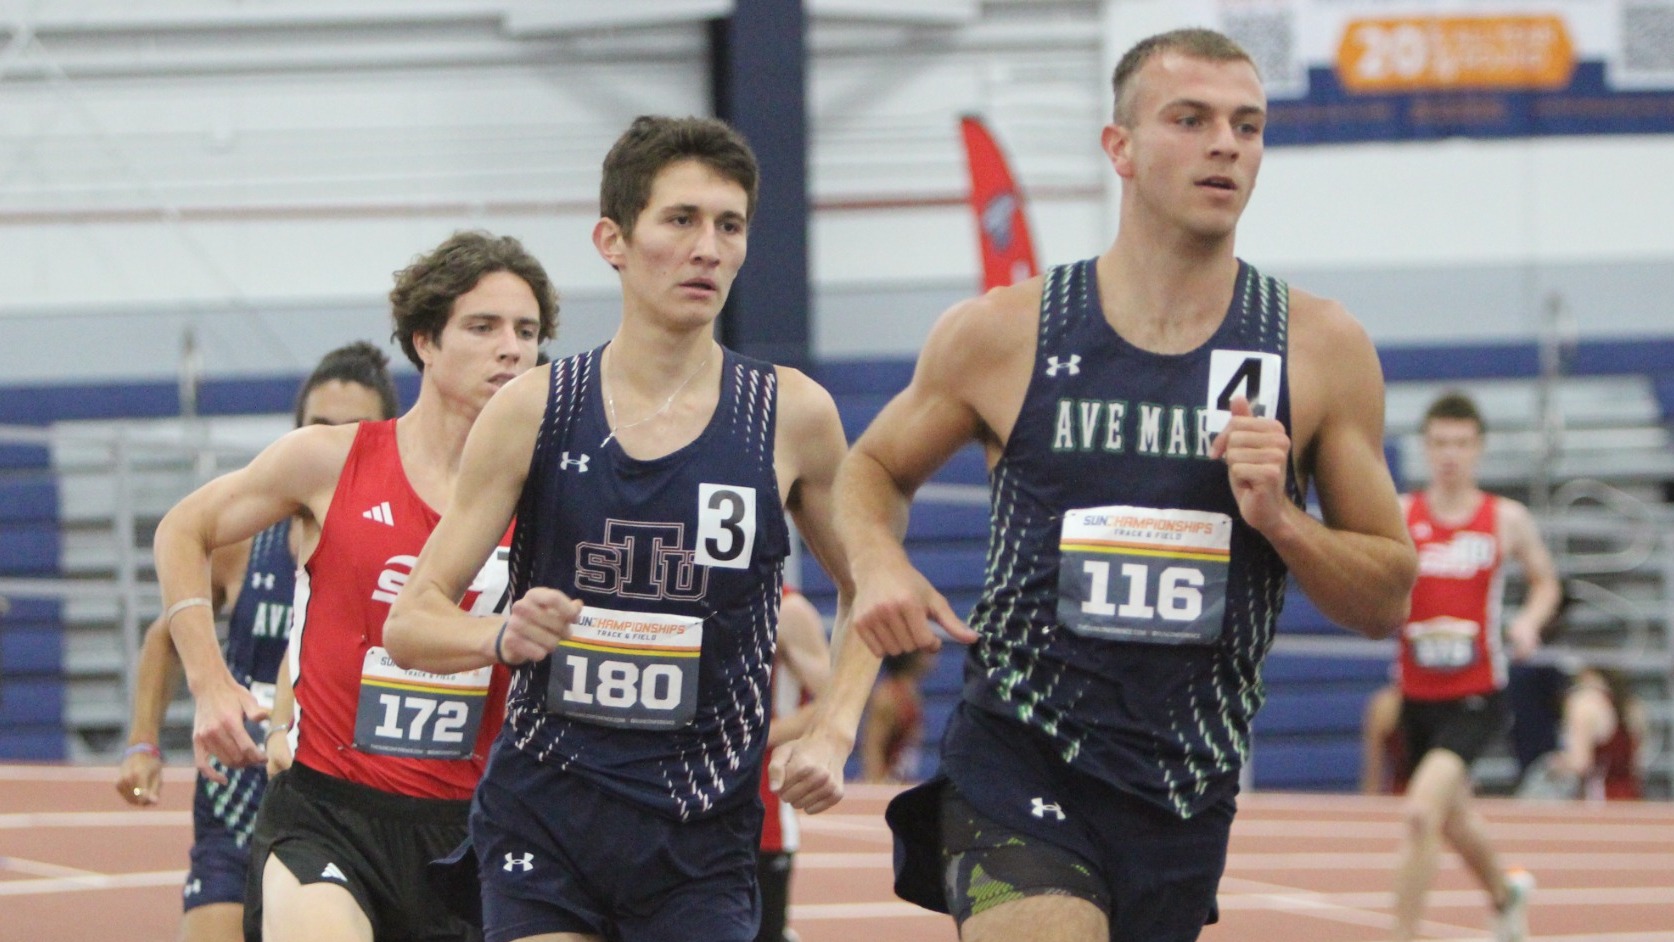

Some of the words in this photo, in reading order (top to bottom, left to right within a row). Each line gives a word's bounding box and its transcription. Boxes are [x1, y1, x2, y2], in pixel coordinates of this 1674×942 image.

[1217, 357, 1267, 417] 4
[1052, 399, 1126, 451] AVE
[1136, 403, 1213, 457] MAR
[705, 490, 745, 561] 3
[1114, 529, 1141, 538] TRACK
[574, 518, 711, 601] STU
[1081, 560, 1205, 621] 116
[579, 616, 685, 634] UNCHAMPIONSHIPS
[598, 629, 621, 638] TRACK
[632, 633, 657, 641] FIELD
[563, 655, 683, 710] 180
[374, 693, 469, 743] 172
